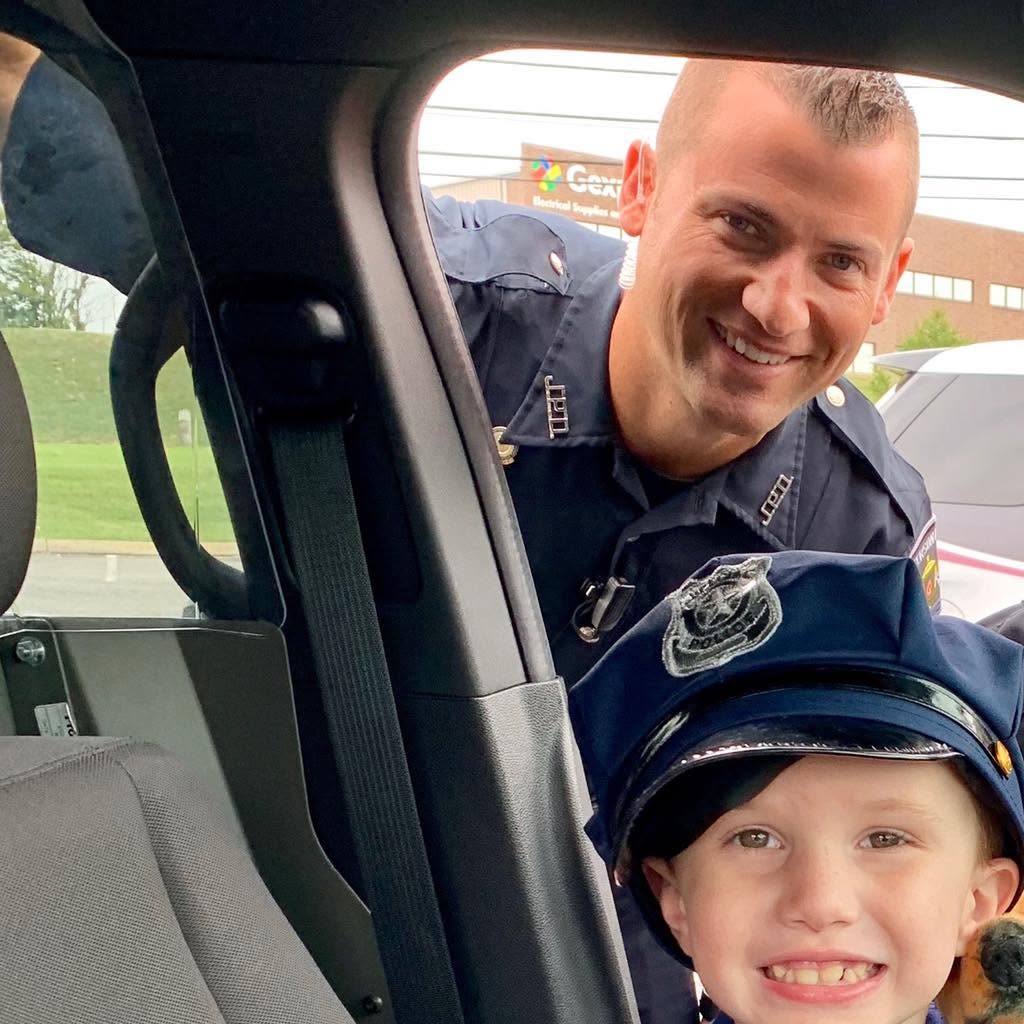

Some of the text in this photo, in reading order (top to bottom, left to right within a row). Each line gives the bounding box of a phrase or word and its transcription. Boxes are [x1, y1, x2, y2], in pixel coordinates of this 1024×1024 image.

[566, 164, 622, 199] Gex
[533, 195, 571, 211] Electrical
[573, 202, 609, 218] Supplies
